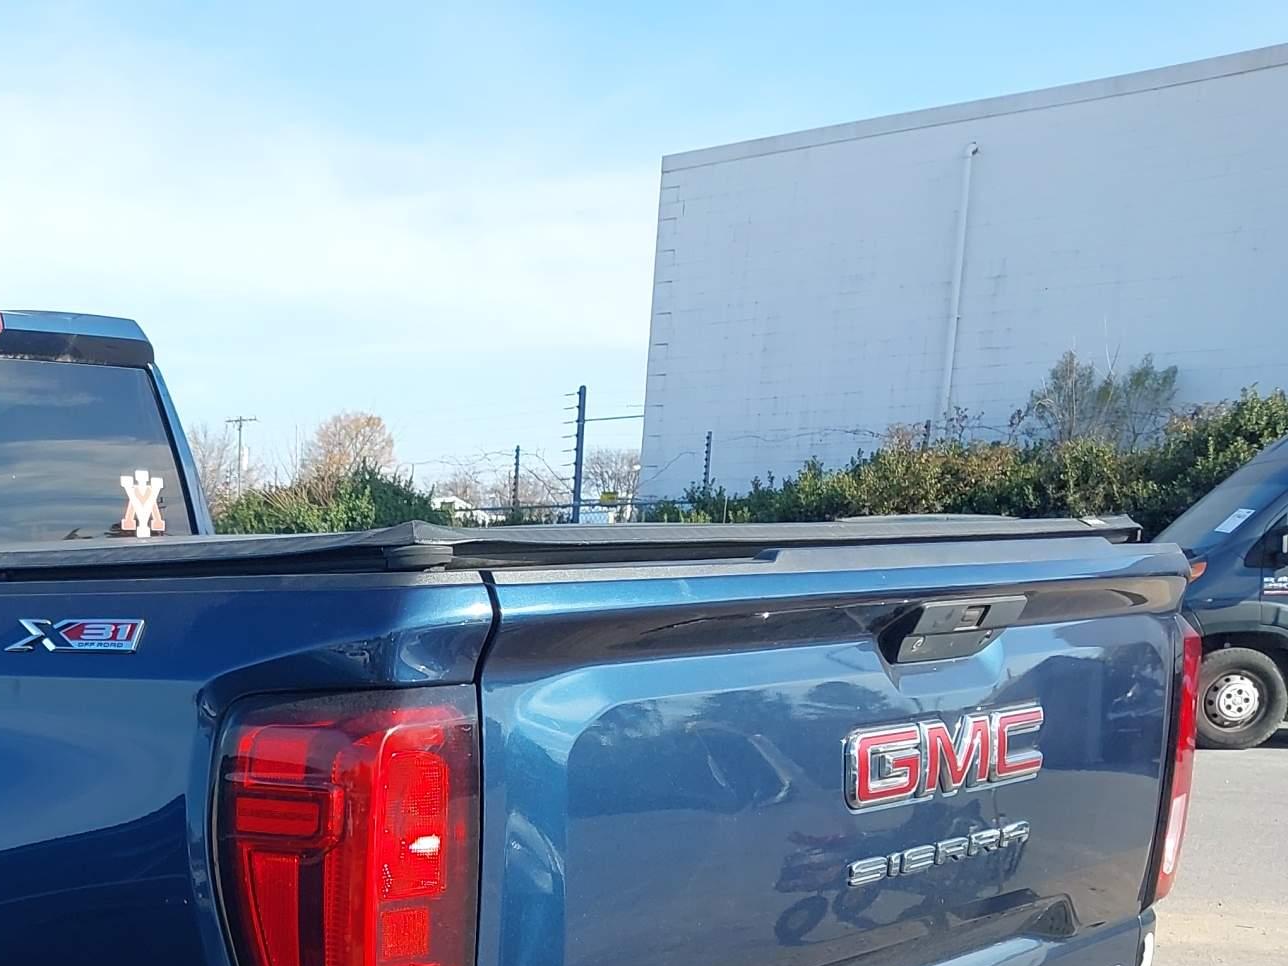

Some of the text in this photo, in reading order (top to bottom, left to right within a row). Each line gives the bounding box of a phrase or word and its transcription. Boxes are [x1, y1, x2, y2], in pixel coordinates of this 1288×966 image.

[4, 619, 144, 652] X31
[844, 705, 1044, 815] GMC
[847, 821, 1031, 886] SIERRA
